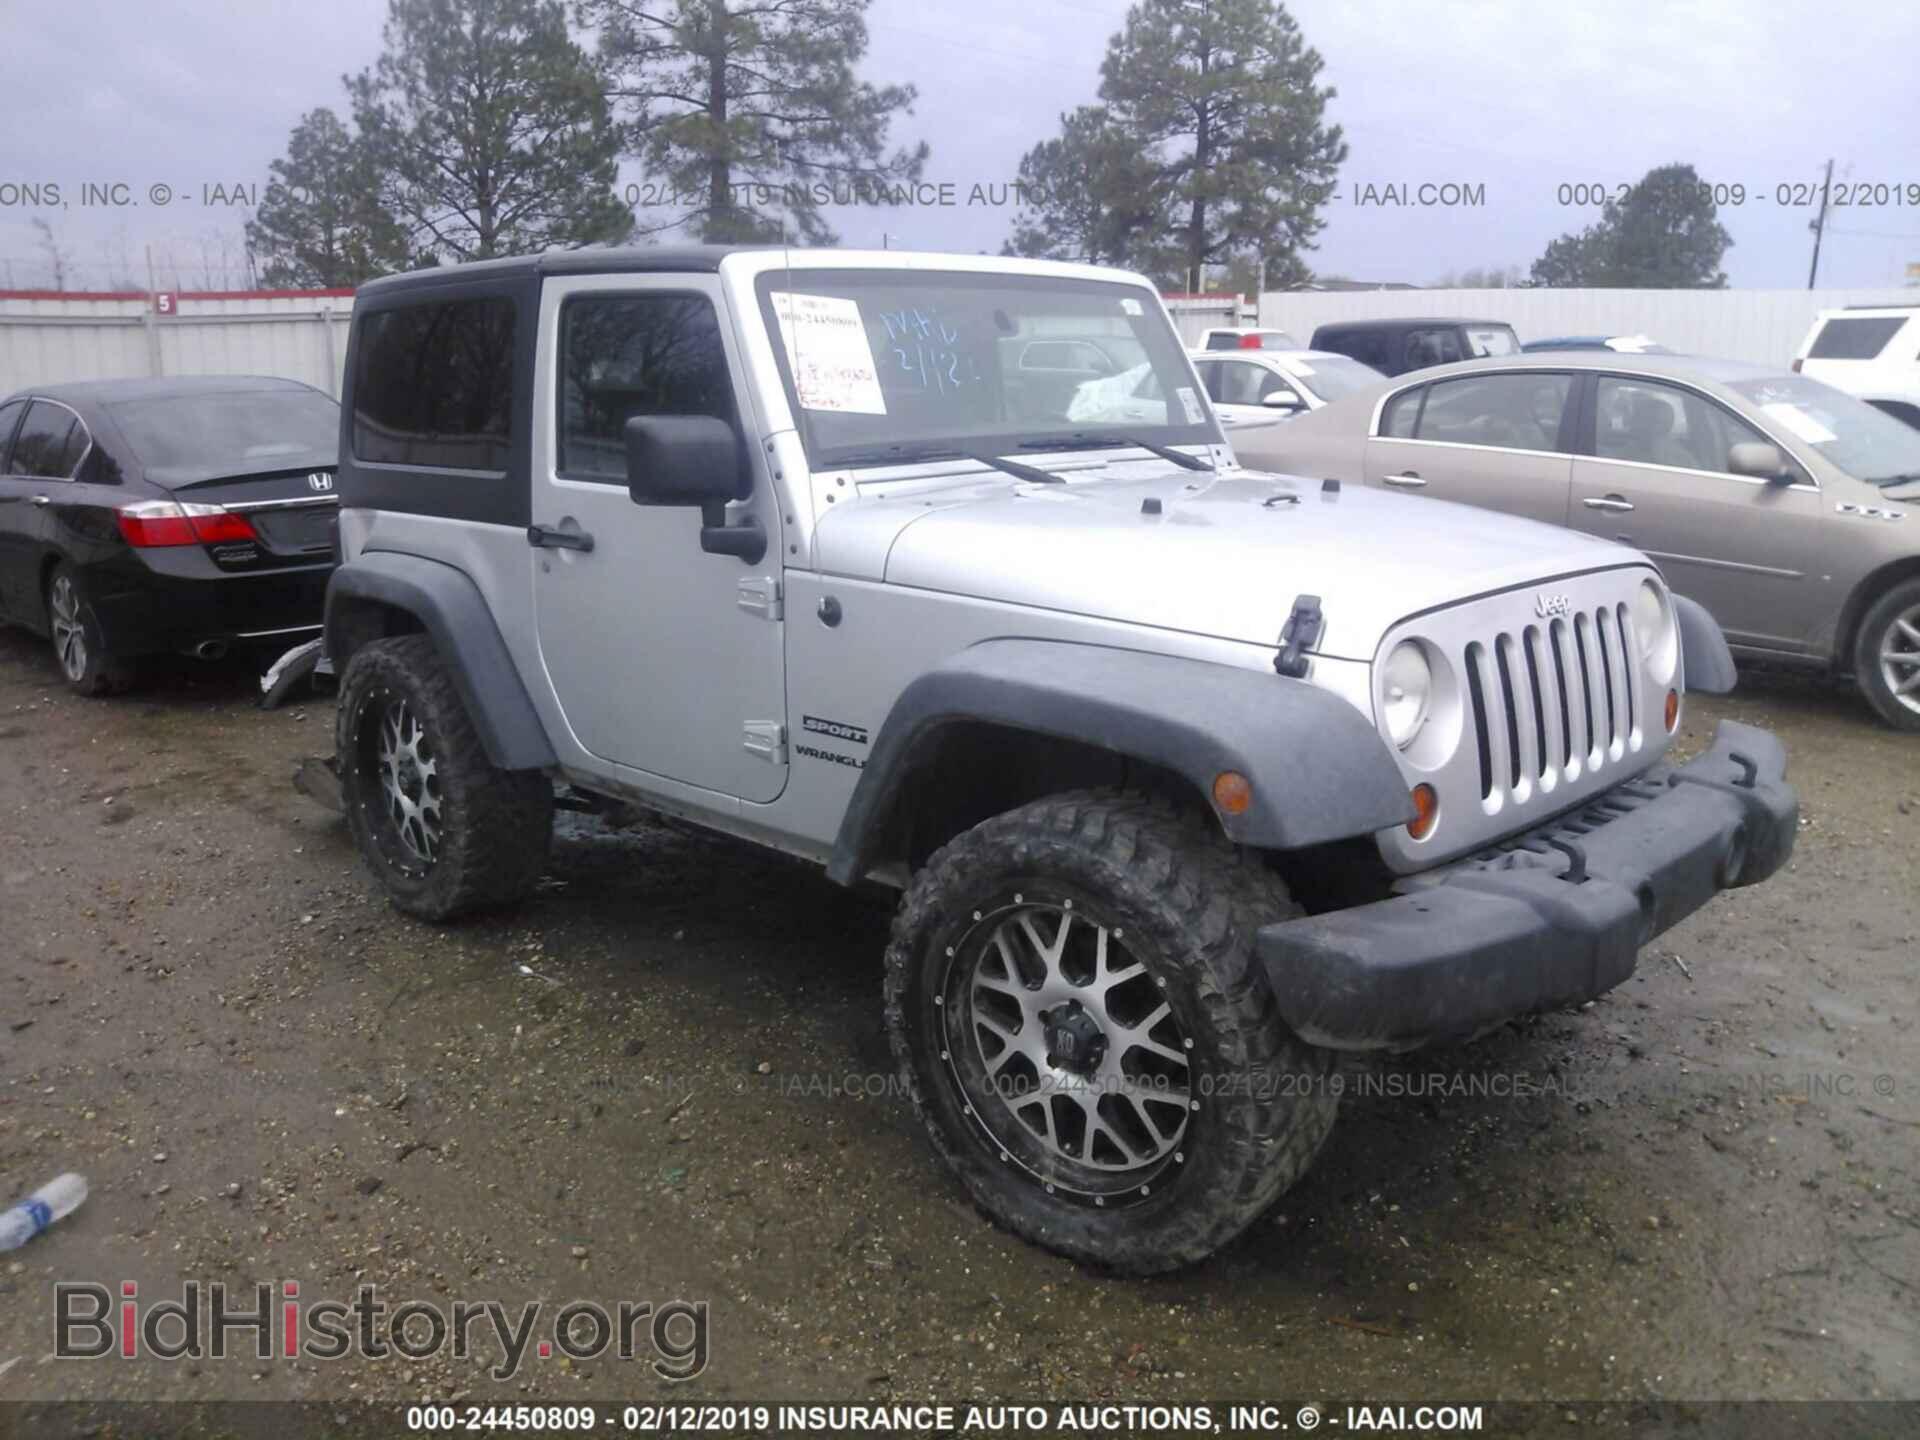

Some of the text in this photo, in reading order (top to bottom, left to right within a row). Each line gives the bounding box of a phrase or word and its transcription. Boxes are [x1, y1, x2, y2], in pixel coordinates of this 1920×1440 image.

[159, 294, 170, 312] 5
[1535, 592, 1569, 619] Jeep
[803, 716, 868, 744] SPORT
